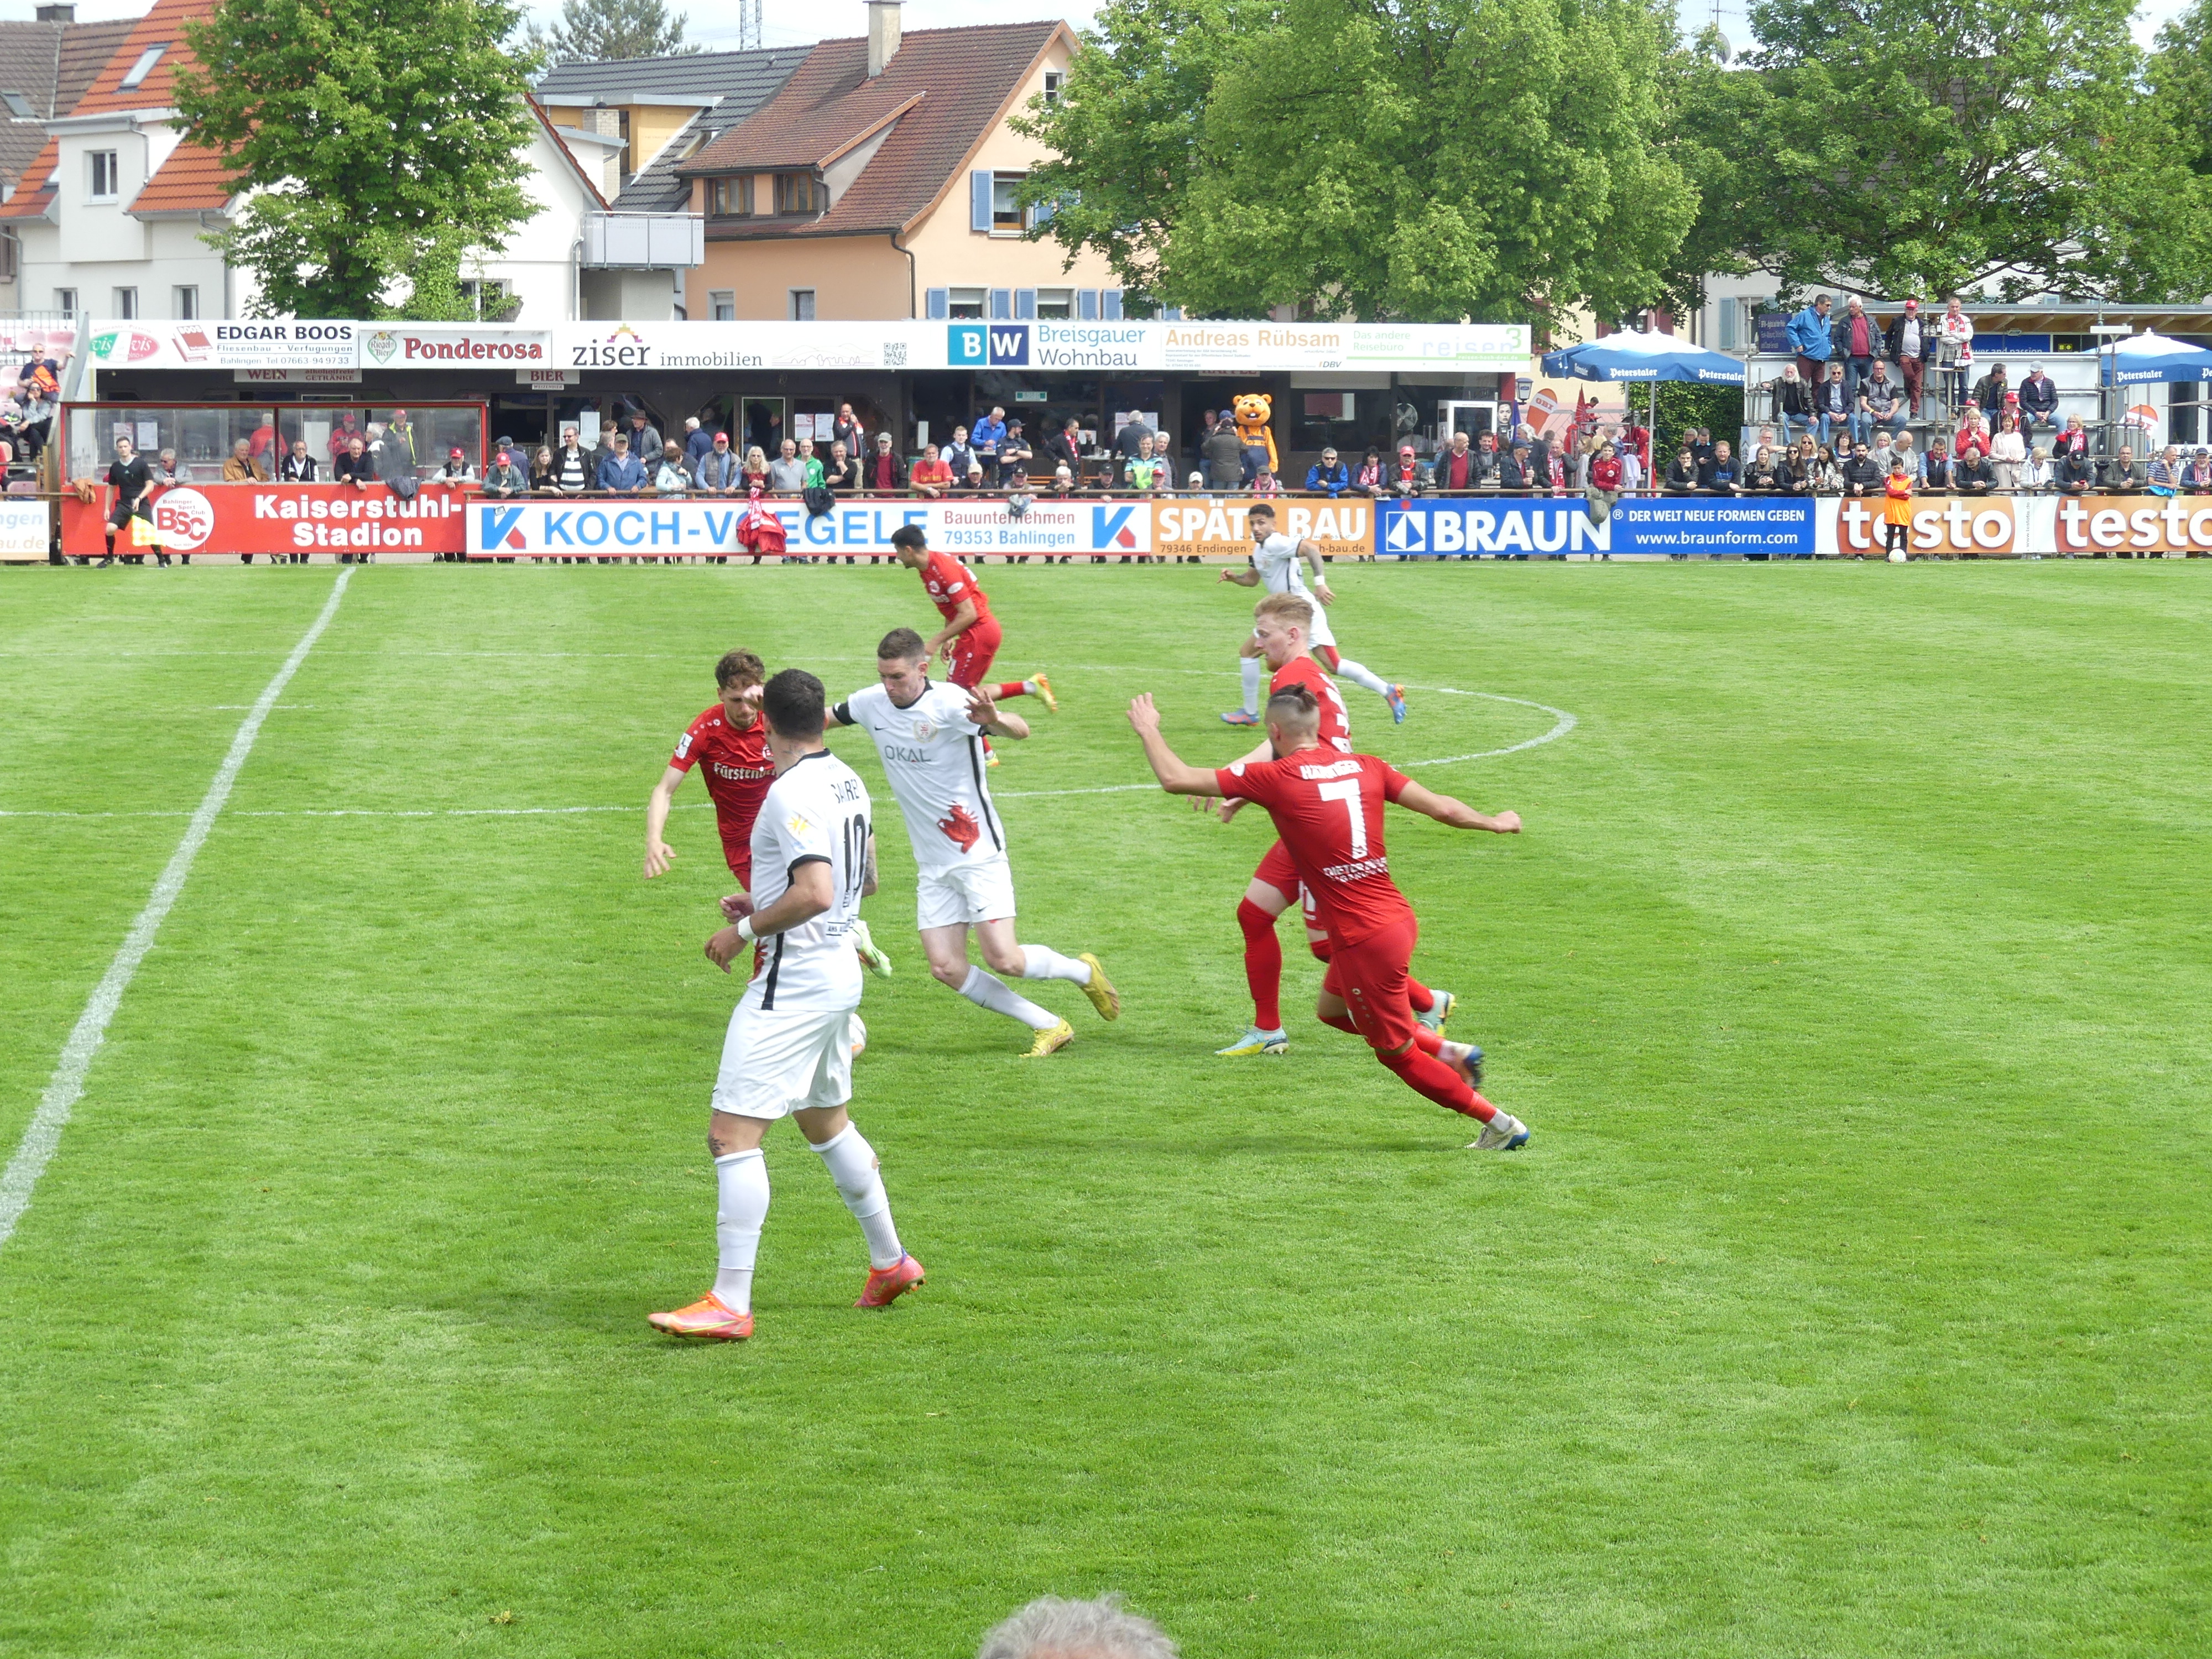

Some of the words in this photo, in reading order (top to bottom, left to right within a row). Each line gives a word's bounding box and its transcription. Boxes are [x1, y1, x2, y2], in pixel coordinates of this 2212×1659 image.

[217, 326, 287, 340] EDGAR
[295, 326, 352, 340] BOOS
[1038, 325, 1146, 347] Breisgauer
[1166, 329, 1249, 346] Andreas
[1258, 330, 1339, 347] Rübsam
[1353, 331, 1371, 340] Das
[1375, 331, 1411, 340] andere
[1505, 327, 1521, 349] 3
[287, 345, 352, 354] Verfugungen
[403, 338, 543, 359] Ponderosa
[572, 338, 650, 367] ziser
[660, 352, 763, 367] immobilien
[962, 332, 982, 357] B
[992, 332, 1022, 357] W
[1353, 342, 1404, 351] Reisebüro
[221, 357, 262, 366] Bahlingen
[1037, 348, 1138, 366] Wohnbau
[247, 369, 287, 380] WEIN
[530, 371, 565, 381] BIER
[1610, 368, 1657, 378] Peterstaler
[2117, 370, 2163, 383] Peterstaler
[1535, 397, 1554, 410] OBI
[254, 494, 462, 519] Kaiserstuhl-
[156, 507, 207, 541] BSC
[1287, 507, 1366, 542] BAU
[1629, 510, 1651, 521] DER
[1653, 510, 1683, 521] WELT
[1684, 510, 1715, 521] NEUE
[1717, 510, 1765, 522] FORMEN
[1767, 510, 1804, 521] GEBEN
[293, 521, 422, 547] Stadion
[544, 510, 928, 546] KOCH-VEGELE
[1434, 510, 1610, 552] BRAUN
[944, 530, 993, 544] 79353
[999, 530, 1074, 547] Bahlingen
[1636, 531, 1798, 544] www.braunform.com
[1160, 544, 1192, 554] 79346
[1197, 544, 1246, 555] Endingen
[885, 745, 931, 762] OKAL
[1317, 778, 1368, 859] 7
[843, 813, 867, 901] 10
